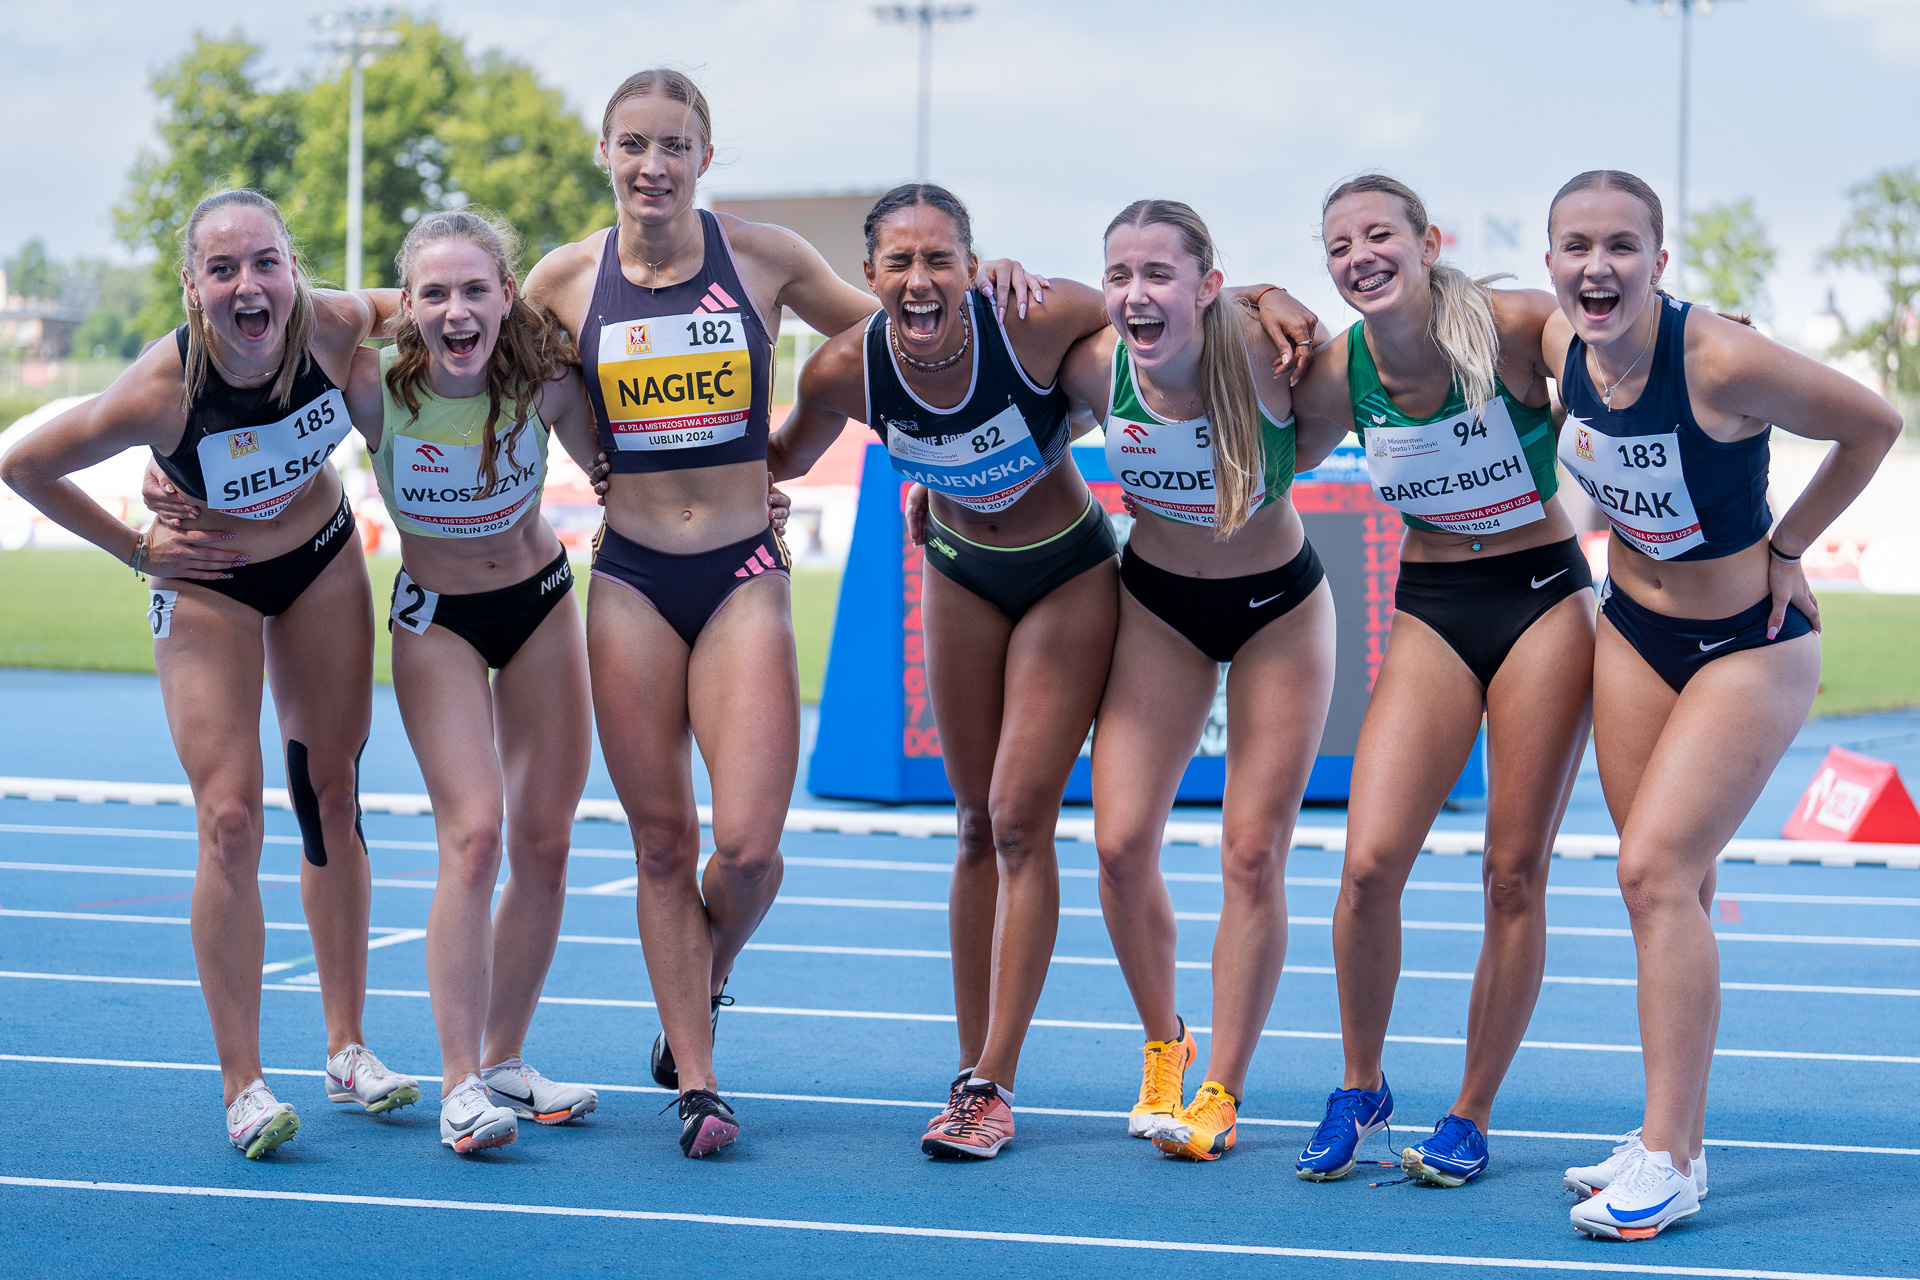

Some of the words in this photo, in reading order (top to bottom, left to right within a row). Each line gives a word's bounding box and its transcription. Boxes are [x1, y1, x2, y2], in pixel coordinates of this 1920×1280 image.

[686, 320, 735, 347] 182
[617, 361, 736, 408] NAGIĘĆ
[293, 399, 335, 439] 185
[628, 422, 645, 431] PZLA
[645, 417, 702, 430] MISTRZOSTWA
[703, 415, 730, 425] POLSKI
[730, 412, 744, 421] U23
[648, 433, 684, 445] LUBLIN
[685, 430, 714, 442] 2024
[971, 426, 1006, 454] 82
[1387, 437, 1423, 445] Ministerstwo
[1453, 414, 1488, 447] 94
[1120, 445, 1157, 455] ORLEN
[1617, 442, 1668, 469] 183
[411, 464, 449, 473] ORLEN
[901, 455, 1036, 488] MAJEWSKA
[1379, 454, 1523, 502] BARCZ-BUCH
[401, 461, 536, 503] WŁOSZZYK
[1120, 469, 1216, 491] GOZDE
[987, 496, 1015, 511] 2024
[1159, 501, 1216, 513] MISTRZOSTWA
[1485, 501, 1514, 515] POLSKI
[1515, 495, 1531, 507] U23
[1577, 474, 1680, 519] OLSZAK
[439, 513, 498, 525] MISTRZOSTWA
[442, 526, 481, 534] LUBLIN
[483, 518, 511, 532] 2024
[1164, 509, 1200, 522] LUBLIN
[1201, 514, 1216, 524] 20
[1472, 518, 1501, 531] 2024
[314, 510, 346, 552] NIKE
[1647, 533, 1675, 542] POLSKI
[1676, 528, 1693, 539] U23
[541, 561, 570, 595] NIKE
[398, 583, 426, 629] 2
